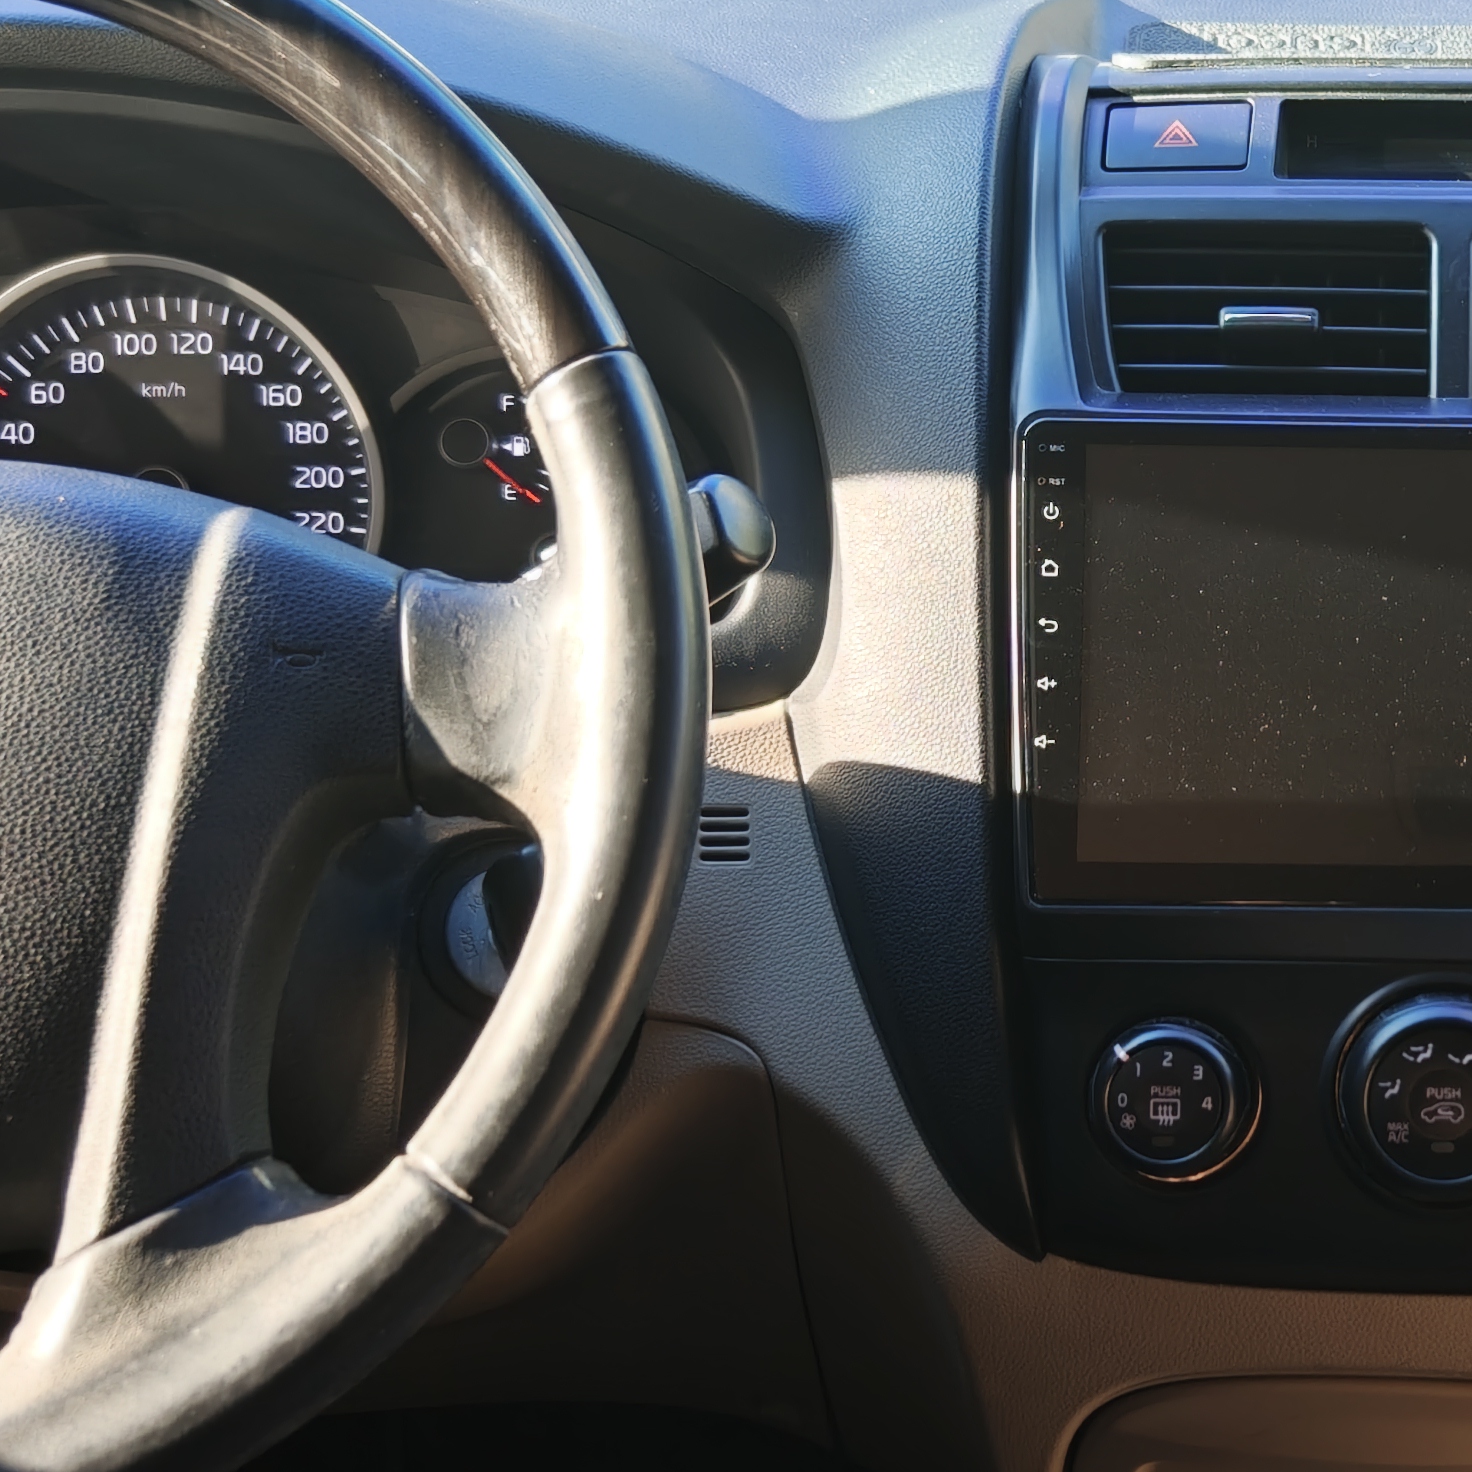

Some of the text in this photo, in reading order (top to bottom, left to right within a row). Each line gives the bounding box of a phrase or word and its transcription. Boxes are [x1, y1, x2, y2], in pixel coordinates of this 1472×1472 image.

[114, 333, 158, 356] 100
[170, 332, 214, 355] 120
[69, 351, 105, 375] 80
[220, 353, 264, 376] 140
[30, 381, 65, 405] 60
[141, 381, 187, 399] km/h
[259, 384, 303, 408] 160
[502, 395, 516, 413] F
[0, 422, 35, 445] 40
[286, 422, 329, 445] 180
[1048, 443, 1066, 453] MIC
[295, 466, 345, 490] 200
[1048, 477, 1066, 486] RST
[503, 484, 518, 502] E
[1162, 1051, 1173, 1067] 2
[1192, 1064, 1203, 1081] 3
[1150, 1085, 1181, 1097] PUSH
[1426, 1086, 1462, 1099] PUSH
[1117, 1093, 1128, 1108] 0
[1201, 1096, 1213, 1111] 4
[1387, 1131, 1410, 1143] A/C
